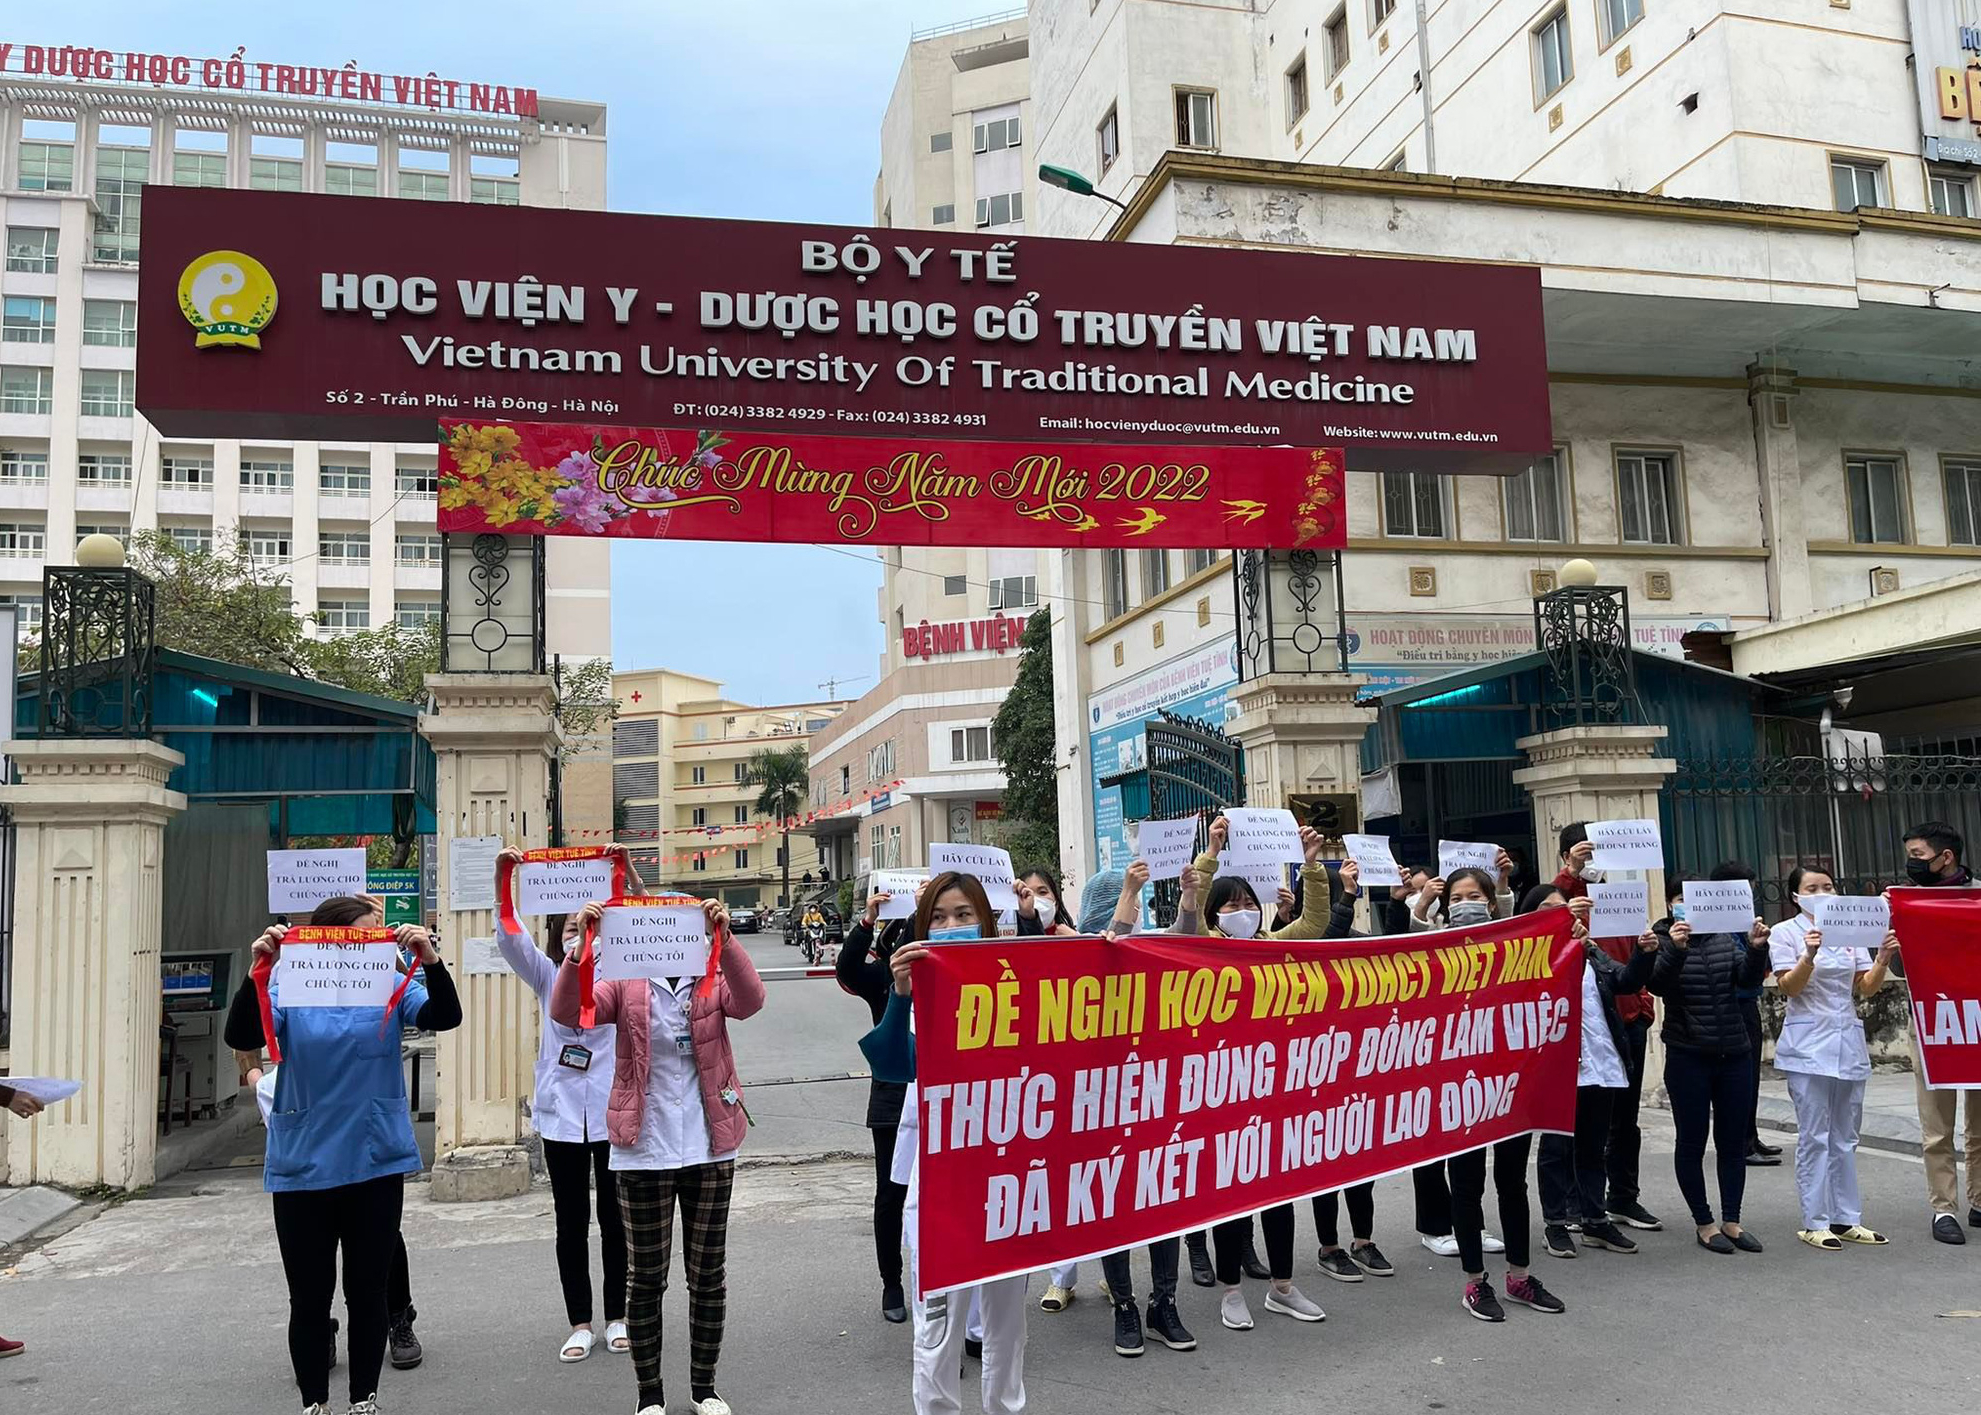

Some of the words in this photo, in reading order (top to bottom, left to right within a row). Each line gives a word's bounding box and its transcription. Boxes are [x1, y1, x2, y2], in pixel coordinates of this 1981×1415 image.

[24, 45, 114, 82] DƯỢC
[126, 53, 190, 88] HỌC
[203, 46, 246, 89] CỔ
[256, 60, 381, 101] TRUYỀN
[393, 71, 459, 111] VIỆT
[469, 83, 538, 117] NAM
[801, 234, 881, 284] BỘ
[894, 246, 934, 278] Y
[950, 240, 1019, 282] TẾ
[321, 272, 438, 319] HỌC
[456, 275, 585, 327] VIỆN
[605, 287, 639, 324] Y
[700, 290, 839, 338] DƯỢC
[857, 299, 957, 343] HỌC
[973, 291, 1040, 342] CỔ
[1054, 304, 1242, 351] TRUYỀN
[1255, 315, 1354, 362] VIỆT
[1367, 325, 1477, 362] NAM
[205, 325, 249, 334] VUTM
[400, 335, 622, 373] Vietnam
[640, 344, 878, 392] University
[895, 356, 955, 387] Of
[972, 360, 1209, 396] Traditional
[1224, 371, 1414, 404] Medicine
[326, 389, 350, 404] Số
[353, 393, 365, 404] 2
[380, 391, 419, 407] Trần
[425, 392, 458, 408] Phú
[473, 395, 497, 409] Hà
[501, 396, 548, 414] Đông
[563, 398, 586, 412] Hà
[590, 399, 619, 415] Nội
[673, 403, 701, 416] ĐT:
[704, 404, 744, 419] (024)
[746, 405, 784, 419] 3382
[788, 406, 826, 420] 4929
[837, 408, 869, 422] Fax:
[872, 409, 910, 425] (024)
[912, 411, 950, 425] 3382
[953, 413, 987, 426] 4931
[1040, 417, 1082, 430] Email:
[1085, 418, 1280, 435] hocvienyduoc@vutm.edu.vn
[1323, 425, 1378, 438] Website:
[1380, 427, 1498, 443] www.vutm.edu.vn
[590, 441, 741, 514] Chúc
[713, 446, 877, 538] Mừng
[865, 452, 983, 522] Năm
[989, 454, 1091, 524] Mới
[1095, 463, 1210, 502] 2022
[903, 619, 966, 661] BỆNH
[970, 612, 1026, 654] VIỆN
[1370, 629, 1404, 648] HOẠT
[1408, 625, 1445, 648] ĐỘNG
[1449, 626, 1499, 644] CHUYÊN
[1503, 627, 1533, 644] MÔN
[1634, 625, 1657, 645] TUỆ
[1310, 800, 1340, 828] 2
[313, 860, 338, 869] NGHỊ
[337, 875, 360, 883] CHO
[367, 880, 385, 890] ÔNG
[584, 875, 605, 883] CHO
[649, 917, 677, 928] NGHỊ
[675, 934, 699, 943] CHO
[363, 961, 389, 971] CHO
[623, 952, 662, 963] CHÚNG
[665, 950, 685, 961] TÔI
[305, 977, 347, 989] CHÚNG
[350, 977, 371, 989] TÔI
[956, 959, 1020, 1051] ĐỀ
[1037, 972, 1146, 1045] NGHỊ
[1158, 966, 1242, 1038] HỌC
[1250, 953, 1329, 1025] VIỆN
[1329, 951, 1431, 1009] YDHCT
[1434, 936, 1498, 999] VIỆT
[1497, 935, 1555, 985] NAM
[924, 1066, 1056, 1156] THỰC
[1071, 1052, 1167, 1136] HIỆN
[1179, 1040, 1276, 1115] ĐÚNG
[1284, 1026, 1352, 1097] HỢP
[1356, 1008, 1436, 1078] ĐỒNG
[1502, 992, 1569, 1054] VIỆC
[985, 1158, 1051, 1242] ĐÃ
[1066, 1145, 1126, 1226] KÝ
[1135, 1122, 1205, 1212] KẾT
[1215, 1114, 1272, 1189] VỚI
[1281, 1093, 1376, 1173] NGƯỜI
[1383, 1086, 1432, 1145] LAO
[1439, 1070, 1519, 1135] ĐỘNG
